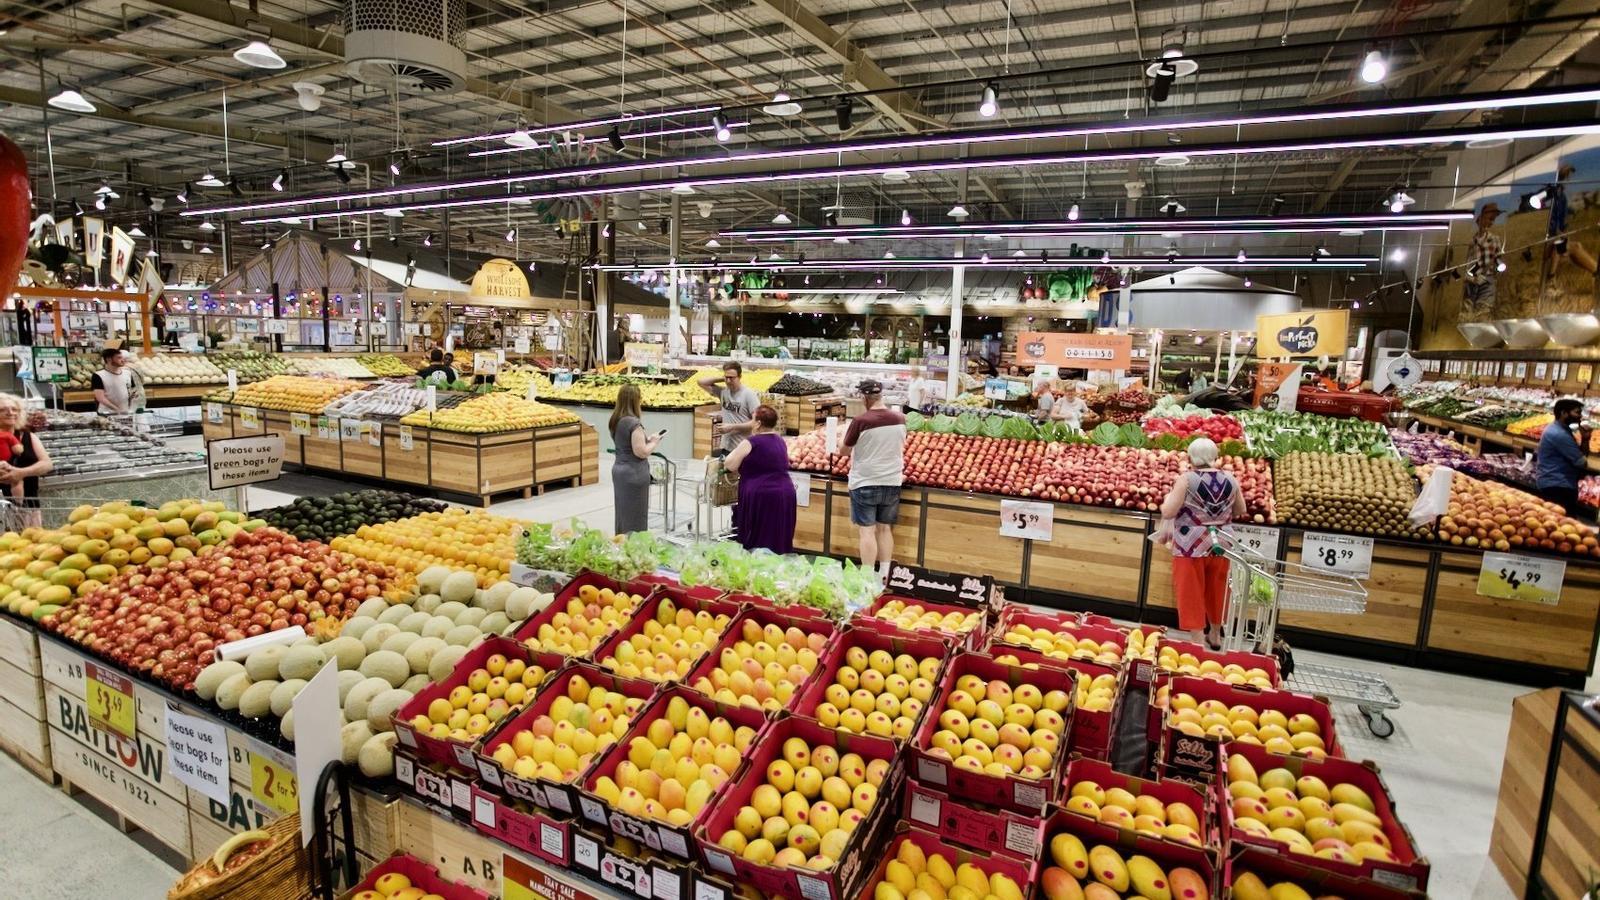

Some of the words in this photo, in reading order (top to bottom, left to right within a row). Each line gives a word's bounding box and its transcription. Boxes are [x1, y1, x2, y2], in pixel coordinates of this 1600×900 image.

[487, 286, 521, 297] HARVEST
[223, 446, 252, 454] Please
[256, 445, 272, 453] use
[213, 461, 240, 470] green
[243, 460, 265, 468] bags
[222, 472, 246, 480] these
[248, 469, 270, 478] items
[1012, 512, 1039, 530] $5.99
[1318, 547, 1354, 566] $8.99
[1499, 568, 1541, 590] $4.99
[97, 686, 123, 721] $3.49
[169, 718, 195, 738] Please
[197, 731, 213, 744] use
[187, 742, 209, 764] bags
[211, 751, 223, 767] for
[1176, 738, 1214, 763] Silky
[82, 754, 116, 784] SINCE
[123, 778, 150, 805] 1922
[197, 765, 218, 785] items
[263, 765, 275, 799] 2
[277, 782, 288, 796] for
[290, 778, 297, 798] $
[578, 844, 592, 857] 20
[529, 880, 556, 900] MANGOES
[544, 875, 559, 893] TRAY
[560, 884, 576, 898] SALE
